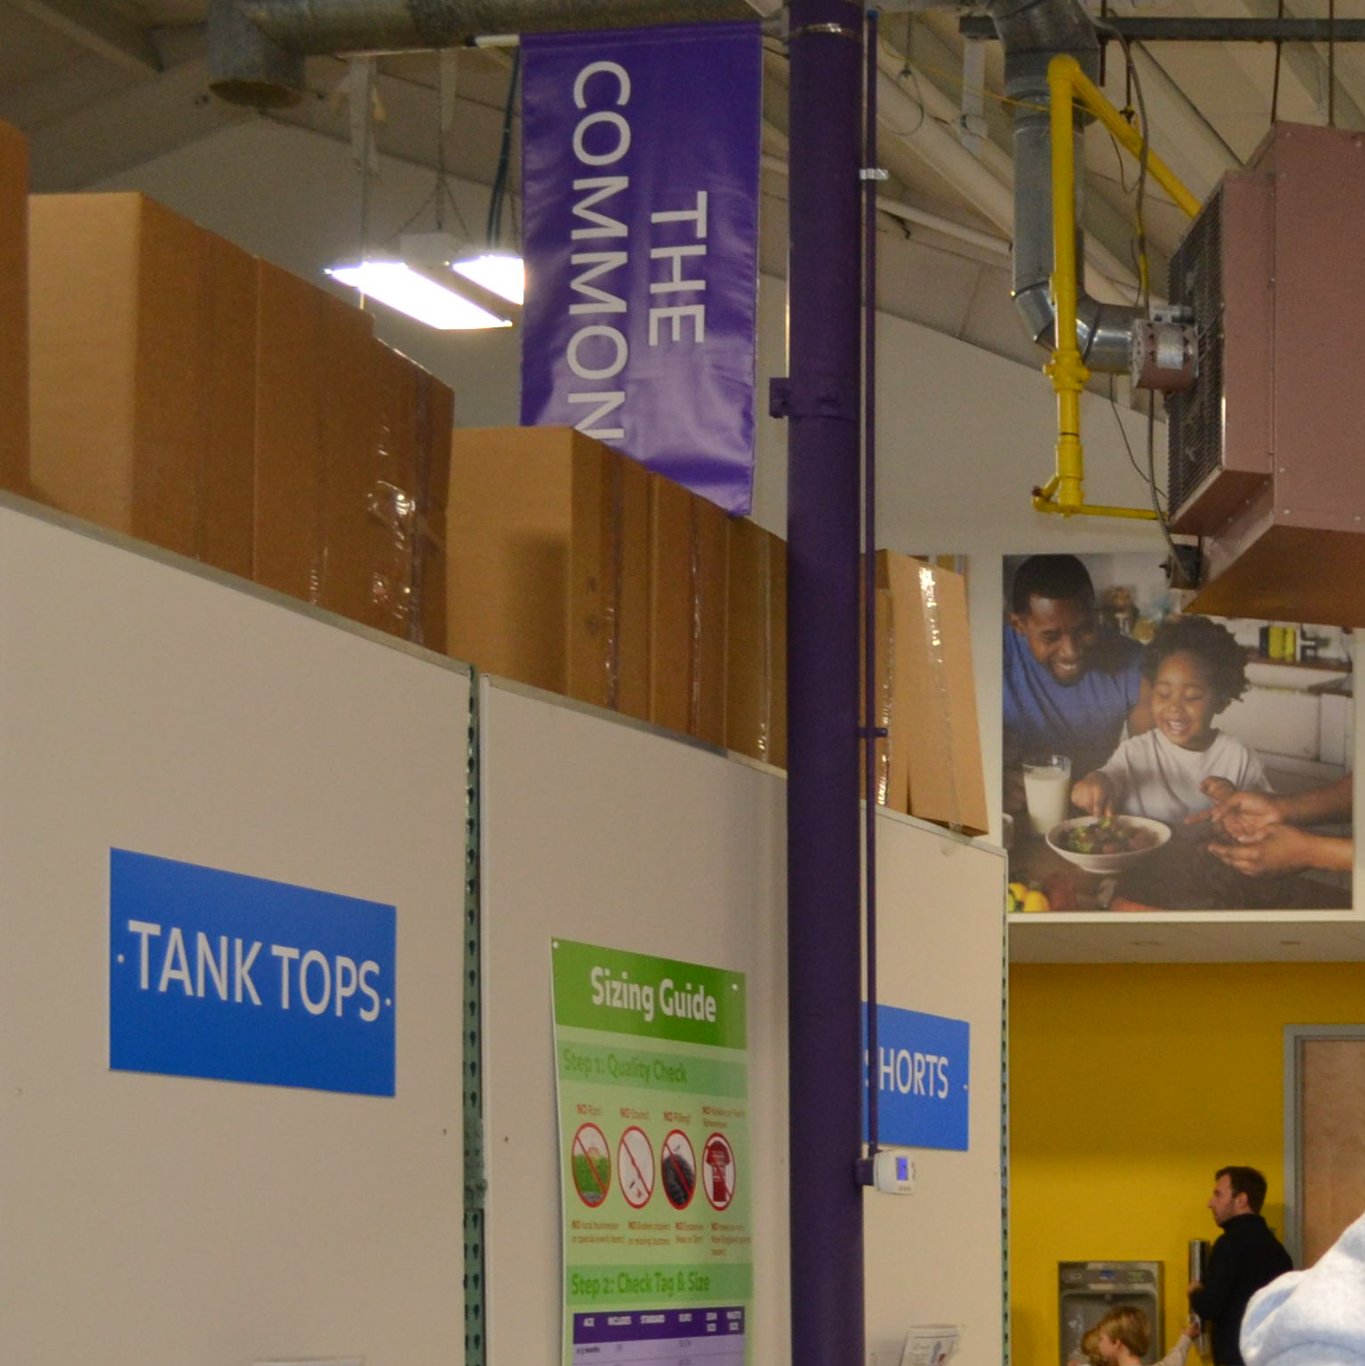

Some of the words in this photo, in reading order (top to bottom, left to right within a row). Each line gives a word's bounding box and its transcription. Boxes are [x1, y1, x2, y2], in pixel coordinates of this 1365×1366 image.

[566, 60, 632, 441] COMMON
[648, 190, 708, 346] THE
[127, 919, 263, 1006] TANK
[271, 944, 381, 1023] TOPS
[590, 966, 656, 1023] Sizing
[658, 978, 717, 1023] Guide
[563, 1048, 595, 1078] Step
[607, 1053, 652, 1086] Quality
[653, 1059, 689, 1085] Check
[865, 1046, 949, 1099] HORTS
[571, 1274, 599, 1298] Step
[617, 1274, 651, 1295] Check
[655, 1274, 676, 1297] Tag
[688, 1271, 711, 1293] Size
